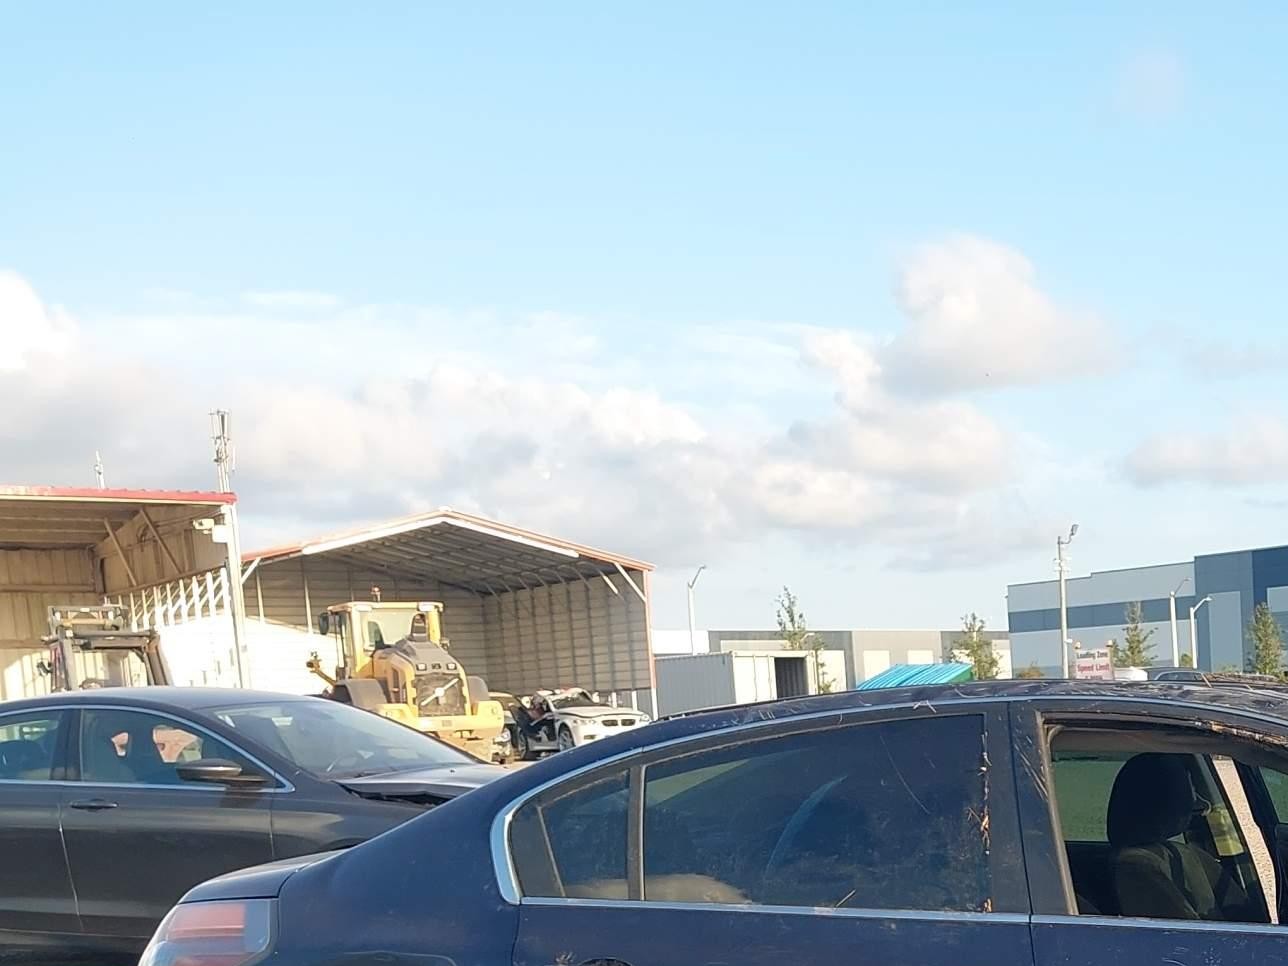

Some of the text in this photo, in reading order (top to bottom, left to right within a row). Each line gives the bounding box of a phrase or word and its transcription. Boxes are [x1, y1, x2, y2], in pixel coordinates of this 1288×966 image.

[1097, 650, 1109, 658] Zone
[1077, 663, 1110, 674] Speed Limit
